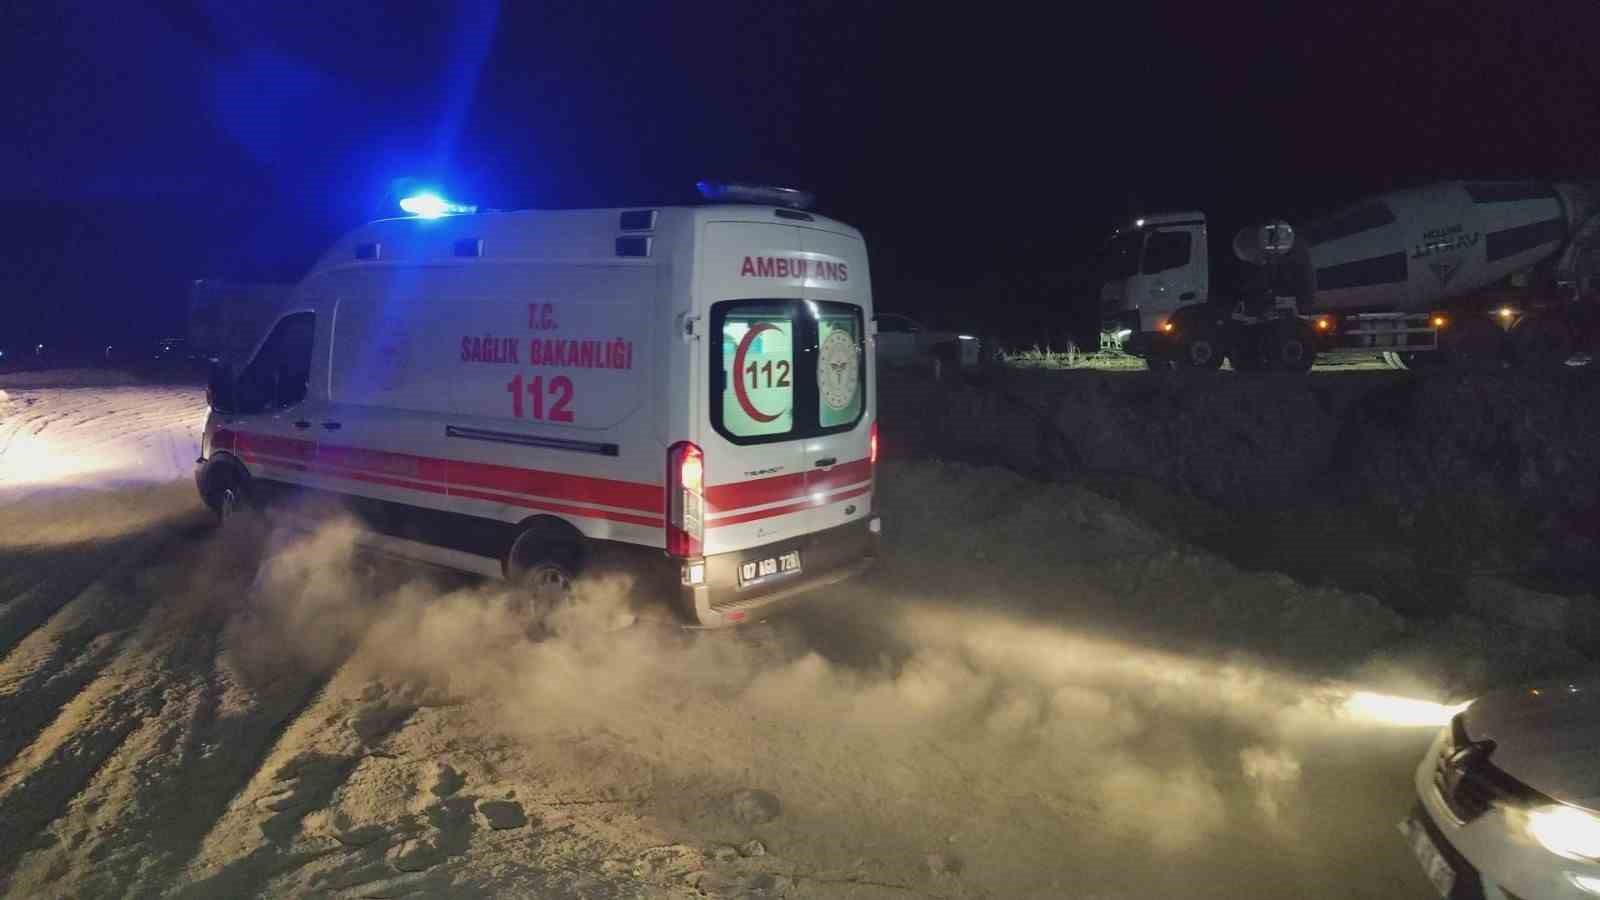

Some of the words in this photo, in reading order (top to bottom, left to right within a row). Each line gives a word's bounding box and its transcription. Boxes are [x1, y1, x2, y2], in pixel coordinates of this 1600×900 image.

[741, 256, 848, 282] AMBULANS
[527, 302, 559, 330] T.C.
[461, 332, 520, 364] SAĞLIK
[530, 336, 633, 369] BAKANLIĞI
[745, 360, 790, 389] 112
[506, 373, 575, 423] 112
